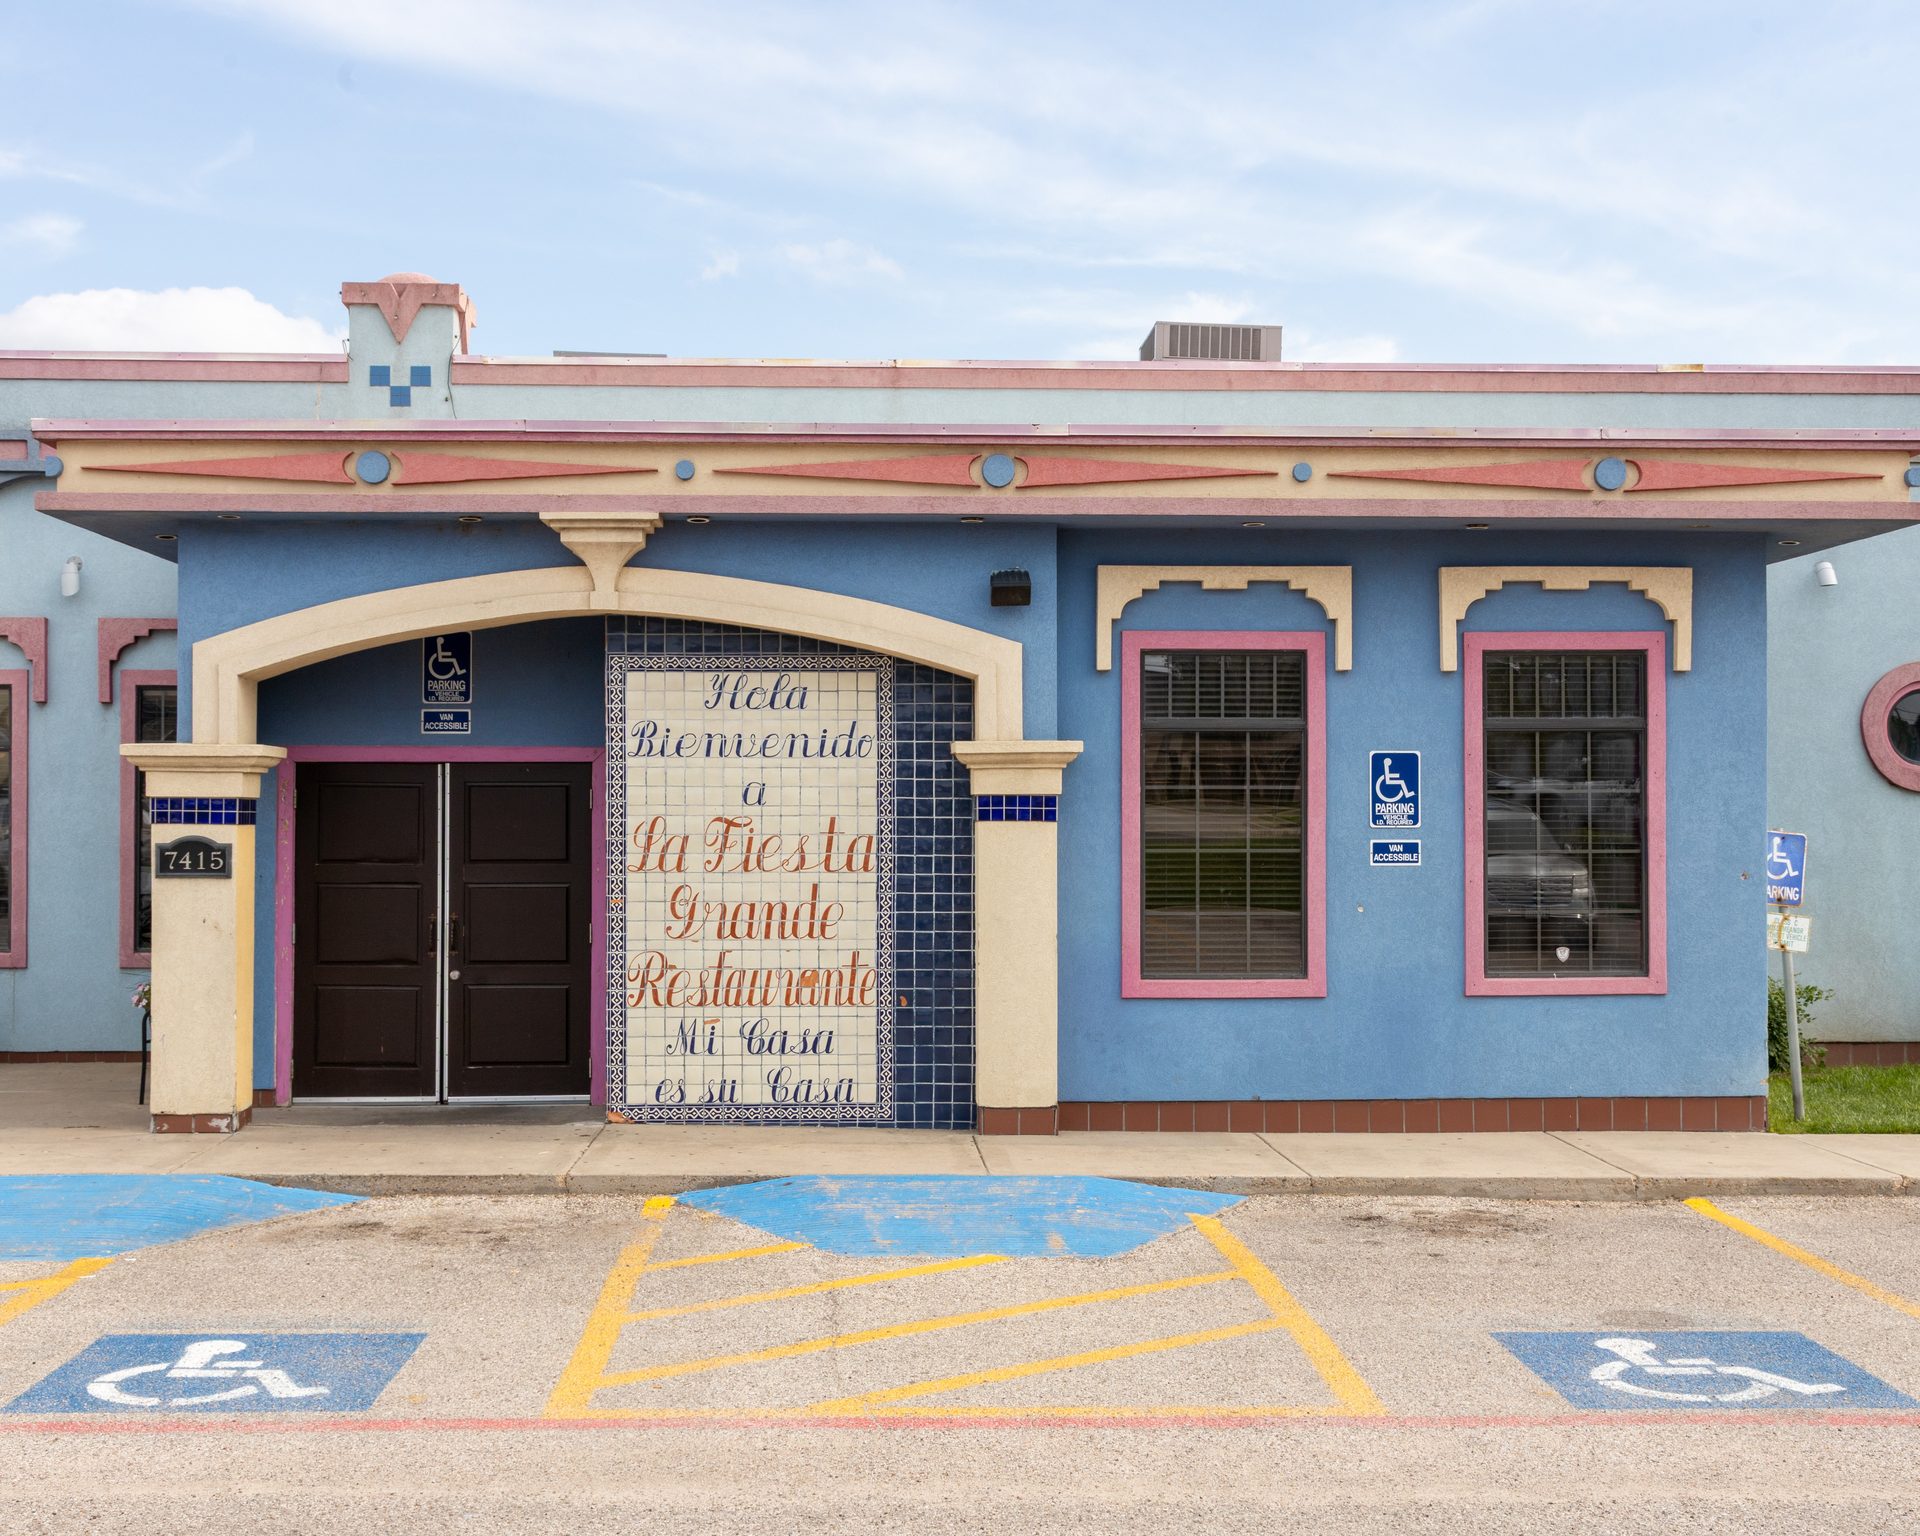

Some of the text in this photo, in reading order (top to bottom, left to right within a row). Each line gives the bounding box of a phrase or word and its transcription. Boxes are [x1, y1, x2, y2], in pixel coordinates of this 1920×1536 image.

[428, 680, 466, 690] PARKING
[704, 673, 808, 710] Hola
[424, 722, 468, 730] ACCESSIBLE
[439, 713, 454, 721] VAN
[627, 720, 875, 758] Bienvenido
[742, 782, 766, 806] a
[1375, 803, 1415, 812] PARKING
[627, 815, 875, 873] La Fiesta
[1388, 844, 1403, 852] VAN
[164, 851, 224, 870] 7415
[1373, 853, 1418, 861] ACCESSIBLE
[1766, 885, 1800, 901] ARKING
[665, 883, 844, 940] Grande
[627, 950, 877, 1008] Restaurante
[666, 1017, 834, 1055] Mi Casa
[655, 1066, 854, 1103] es su Casa
